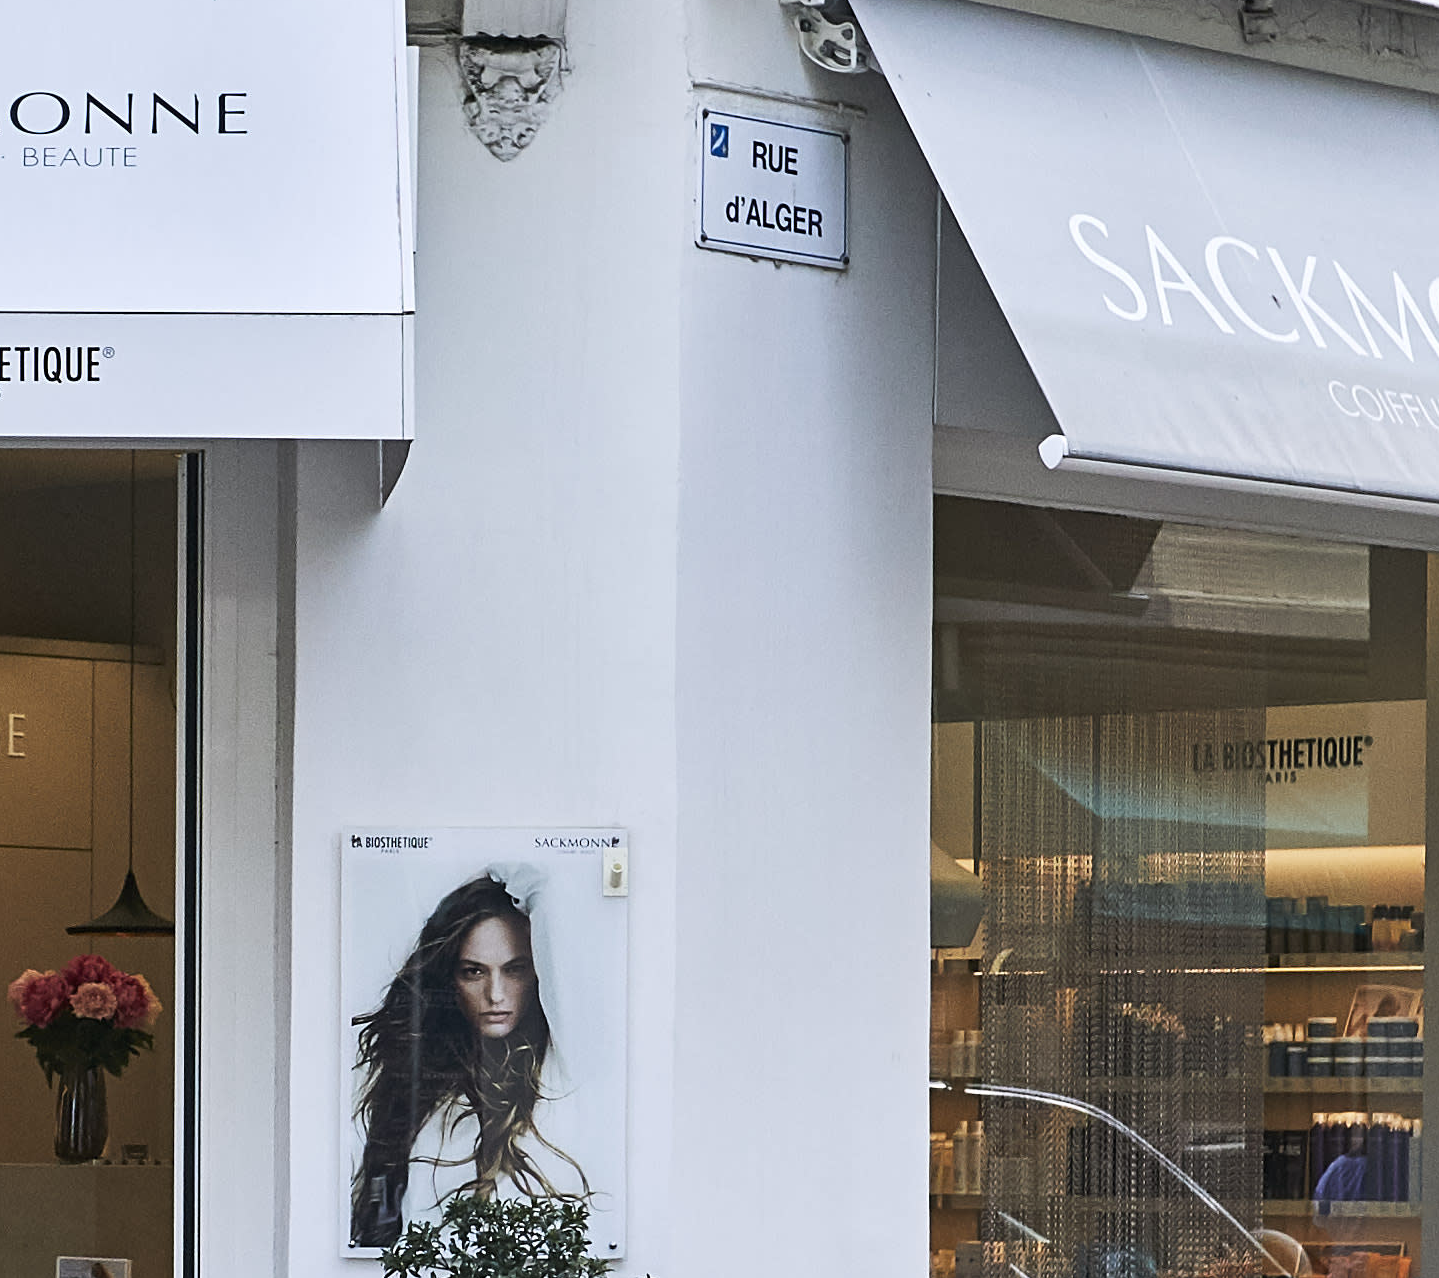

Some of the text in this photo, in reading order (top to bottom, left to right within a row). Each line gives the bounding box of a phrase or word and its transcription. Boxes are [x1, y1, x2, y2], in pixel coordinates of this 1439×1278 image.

[23, 147, 138, 167] BEAUTE
[752, 140, 799, 176] RUE
[726, 195, 823, 237] d'ALGER
[1258, 772, 1297, 784] ARIS
